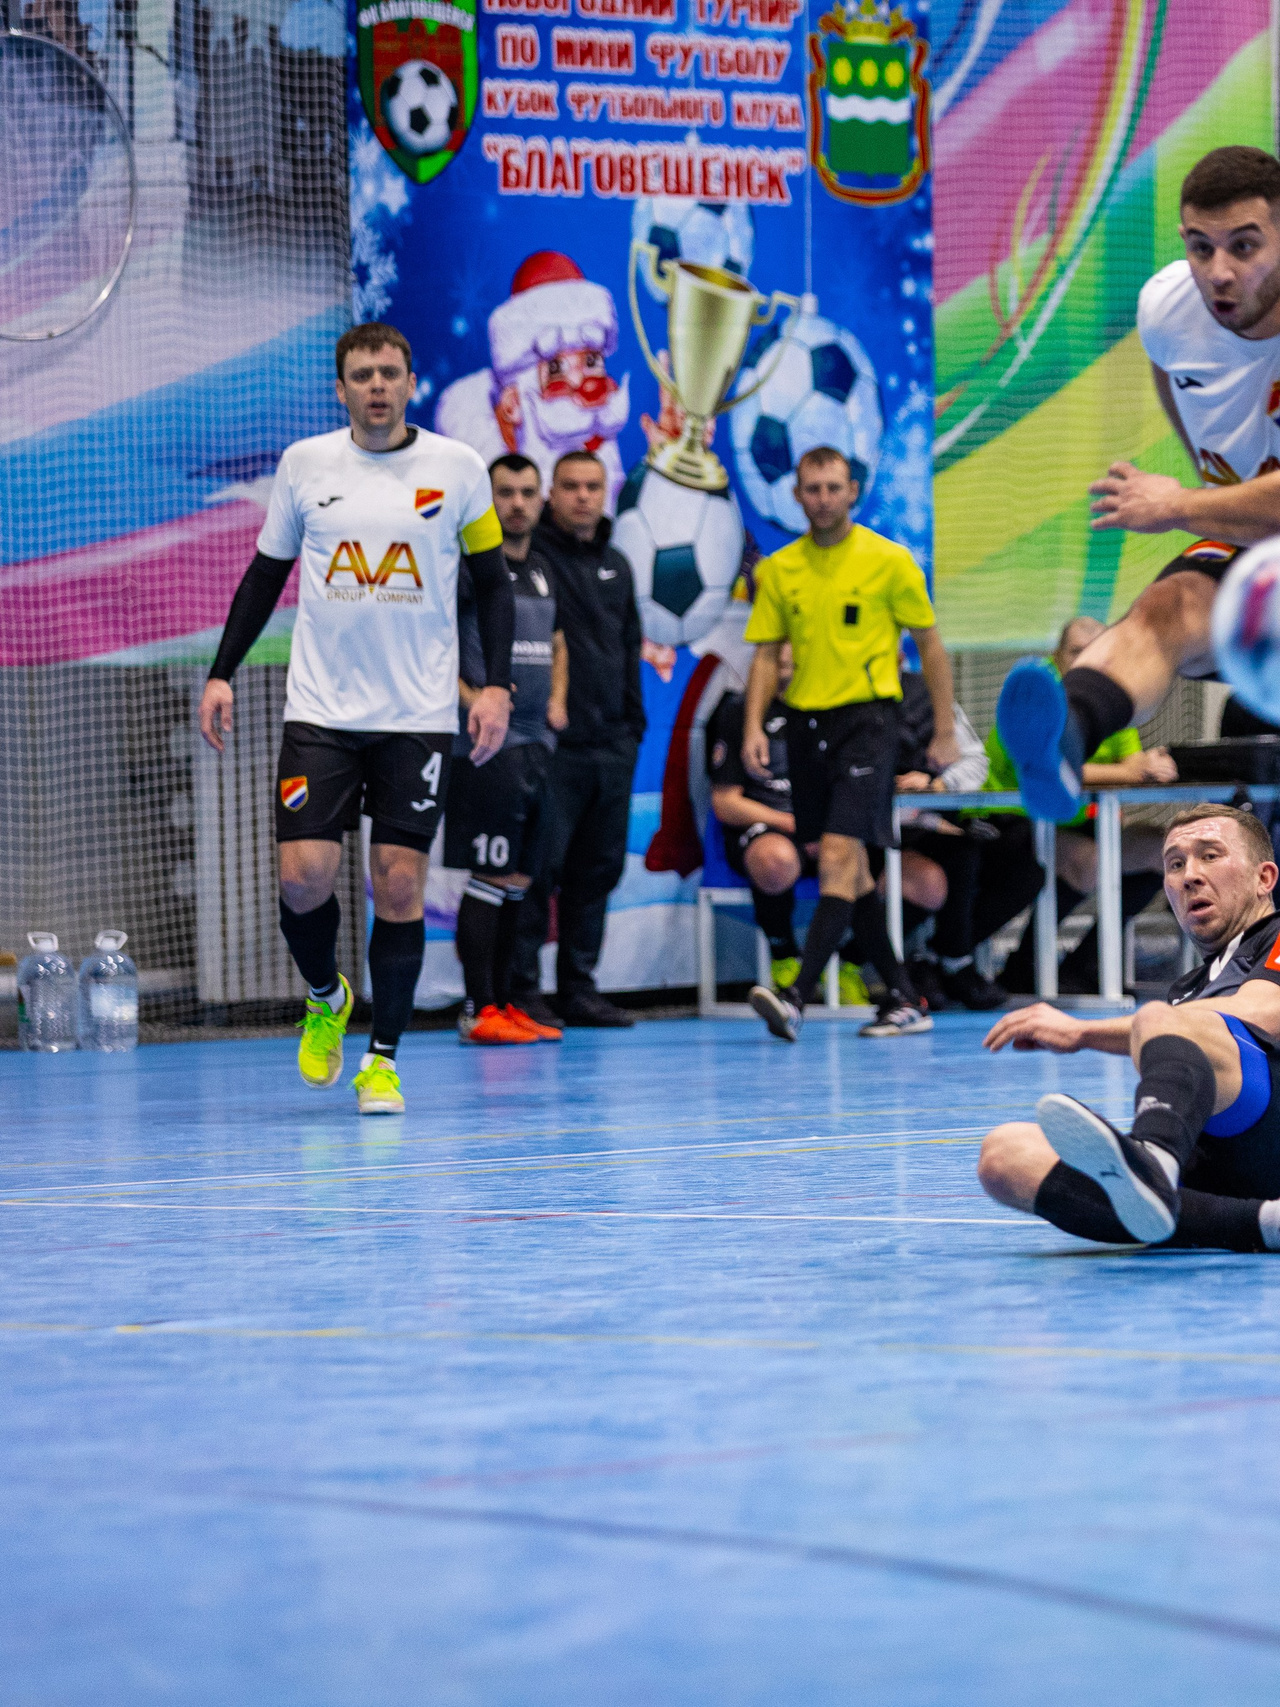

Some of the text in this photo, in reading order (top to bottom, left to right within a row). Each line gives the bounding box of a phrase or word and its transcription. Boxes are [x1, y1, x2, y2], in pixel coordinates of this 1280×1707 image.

[499, 27, 789, 81] ПО МИНИ ФУТБОЛУ
[485, 82, 802, 129] КУБОК ФУТБОЛЬНОГО КЛУБА
[325, 541, 424, 589] AVA
[326, 588, 424, 605] GROUP COMPANY
[421, 751, 443, 796] 4
[472, 833, 510, 868] 10
